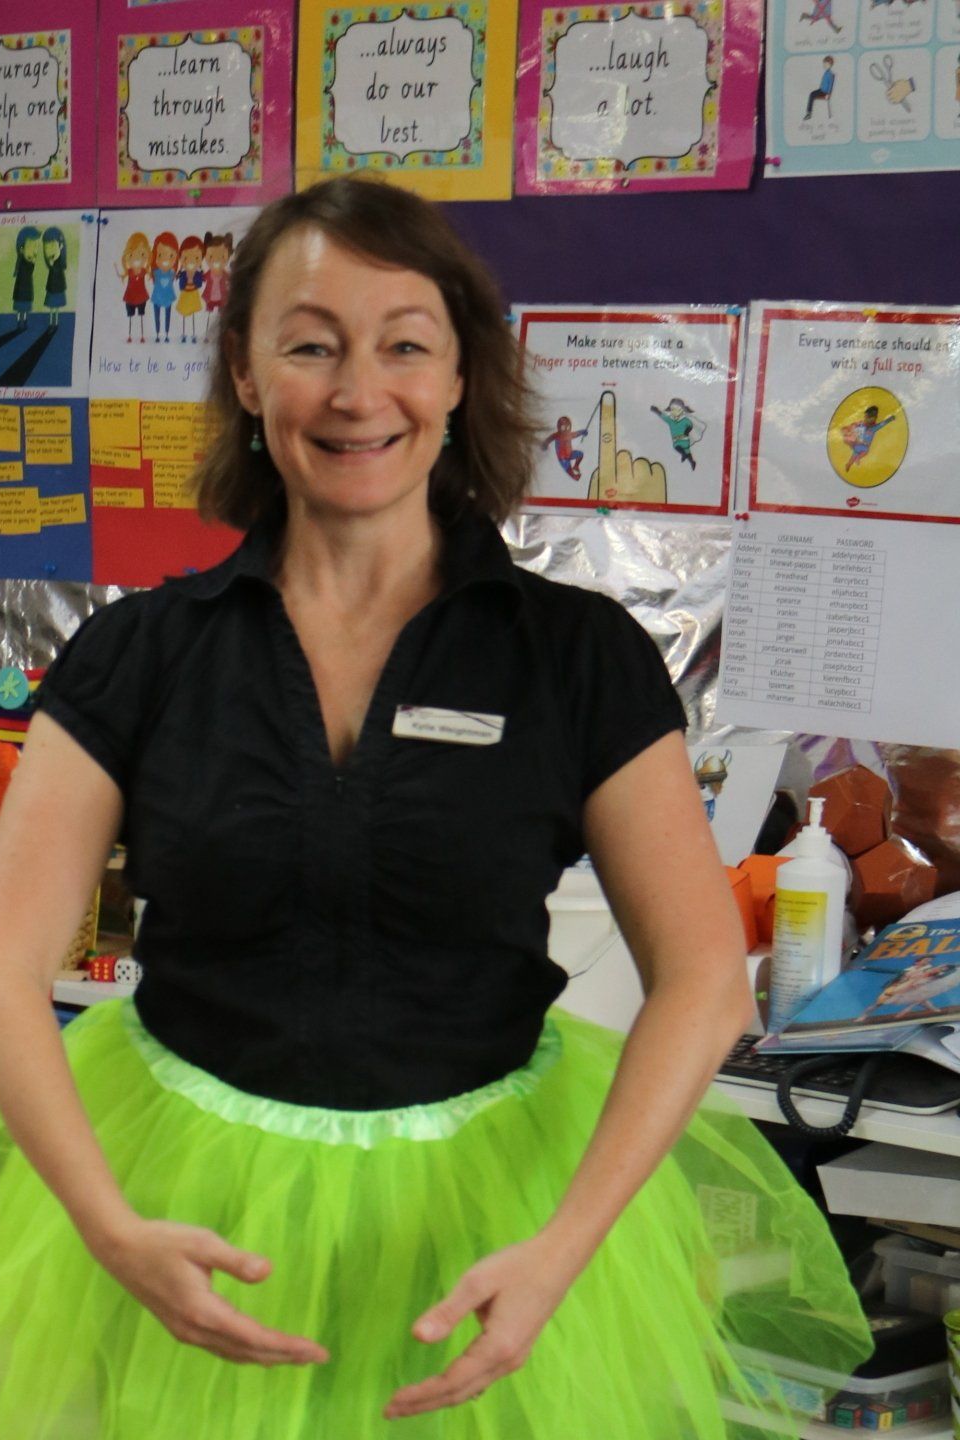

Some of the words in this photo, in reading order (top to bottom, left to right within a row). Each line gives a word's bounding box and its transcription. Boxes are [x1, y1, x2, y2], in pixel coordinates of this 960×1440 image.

[360, 26, 447, 67] ...always
[589, 36, 671, 83] ...laugh
[158, 48, 221, 77] ...learn
[366, 71, 390, 101] do
[401, 81, 439, 99] our
[27, 99, 56, 117] one
[153, 86, 226, 127] through
[597, 100, 609, 117] a
[624, 86, 657, 116] lot.
[148, 127, 230, 157] mistakes.
[380, 115, 422, 144] best.
[566, 335, 596, 349] Make
[600, 338, 623, 349] sure
[676, 339, 684, 349] a
[799, 333, 831, 352] Every
[836, 337, 887, 350] sentence
[891, 337, 931, 351] should
[98, 356, 121, 373] How
[129, 358, 141, 373] to
[147, 356, 159, 374] be
[166, 361, 176, 371] a
[182, 356, 210, 381] good
[533, 355, 564, 370] finger
[568, 358, 598, 369] space
[602, 355, 649, 369] between
[831, 359, 857, 370] with
[862, 362, 869, 370] a
[871, 358, 893, 375] full
[778, 535, 813, 544] USERNAME
[837, 538, 874, 548] PASSWORD
